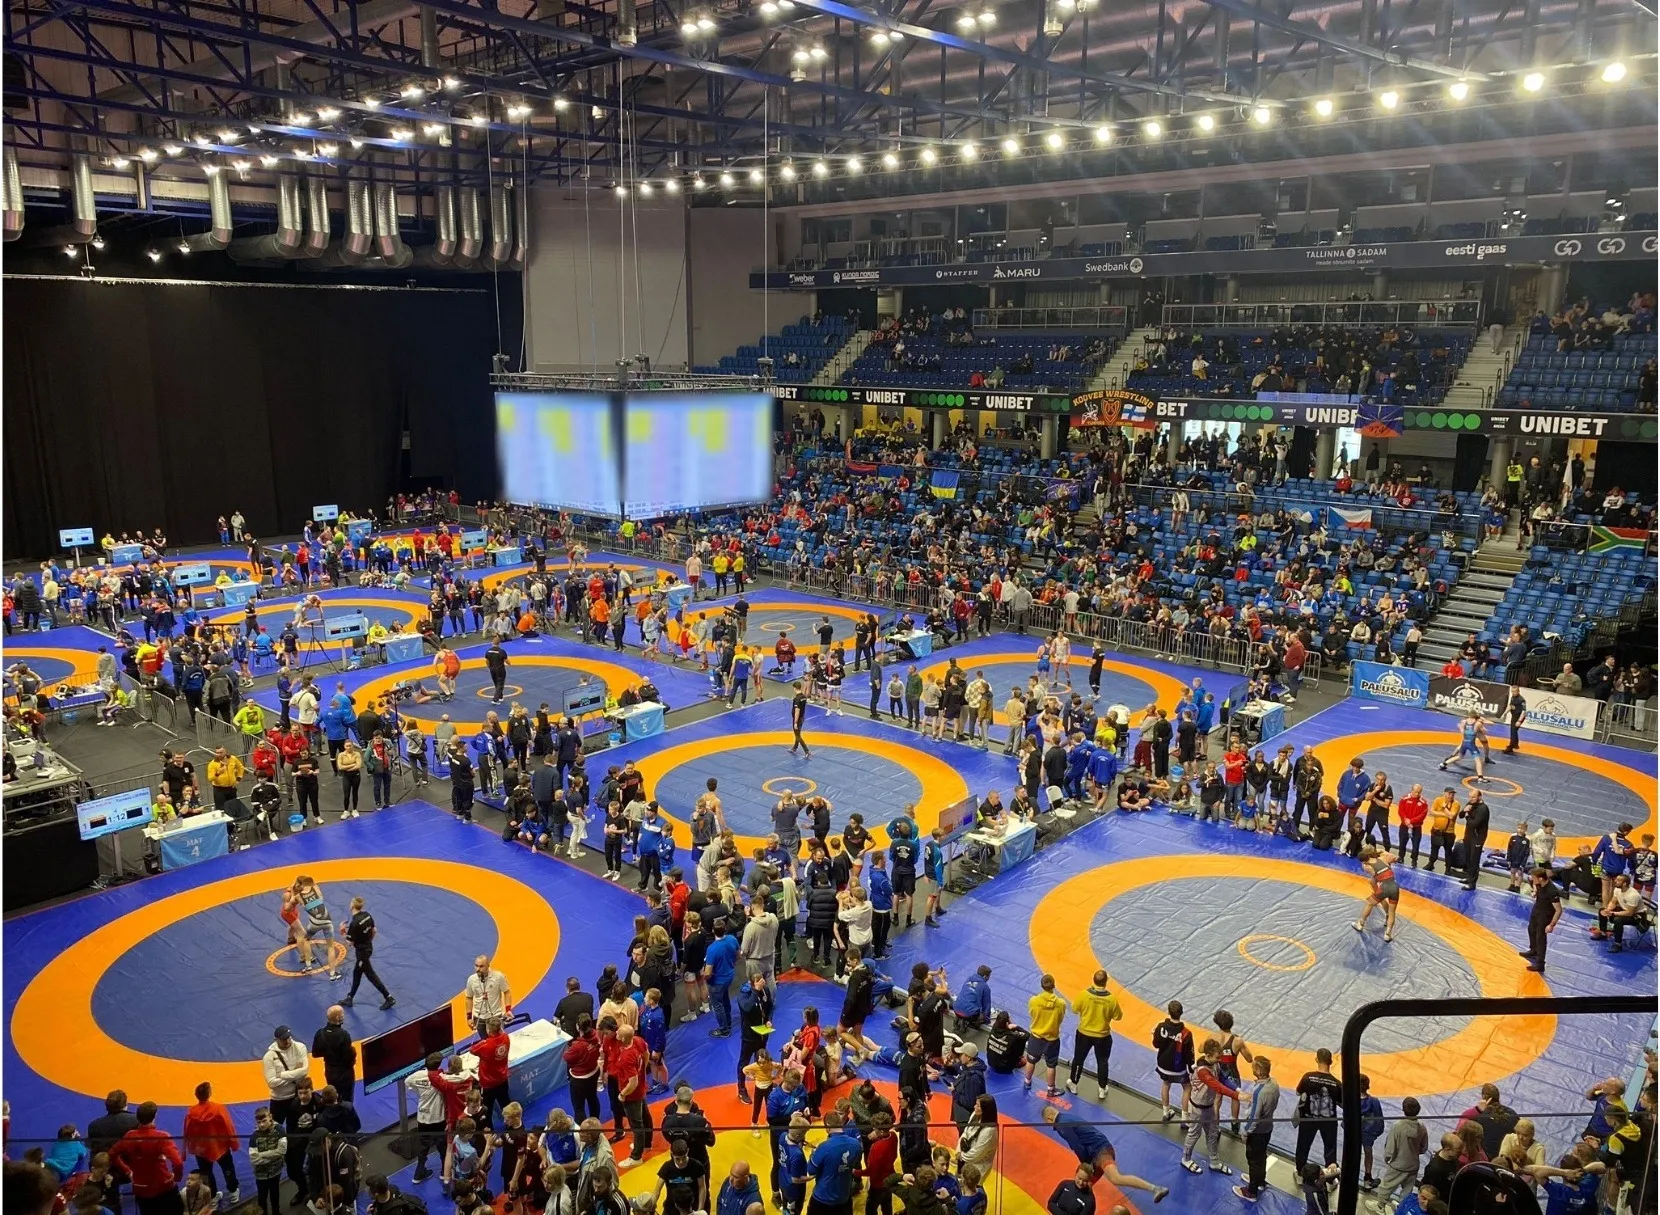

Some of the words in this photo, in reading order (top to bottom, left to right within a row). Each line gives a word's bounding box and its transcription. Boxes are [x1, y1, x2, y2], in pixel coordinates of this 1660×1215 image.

[1306, 250, 1345, 259] TALLINNA
[1357, 248, 1387, 256] SADAM
[1445, 243, 1476, 256] eesti
[1477, 244, 1507, 260] gaas
[1007, 268, 1041, 278] MARU
[1085, 262, 1129, 272] Swedbank
[794, 273, 815, 283] weber
[865, 390, 906, 404] UNIBET
[985, 395, 1034, 410] UNIBET
[1072, 391, 1103, 407] KOOVEE
[1105, 390, 1154, 409] WRESTLING
[1305, 407, 1358, 425] UNIBE
[1519, 415, 1609, 436] UNIBET
[236, 595, 246, 603] 10
[1360, 679, 1420, 700] PALUSALU
[1435, 693, 1499, 714] PALUSALU
[1526, 710, 1585, 729] ALUSALU
[641, 723, 648, 733] 5
[107, 812, 126, 823] 1:12
[186, 836, 204, 848] MAT
[191, 845, 200, 857] 4
[520, 1067, 540, 1085] MAT
[526, 1081, 535, 1098] 1
